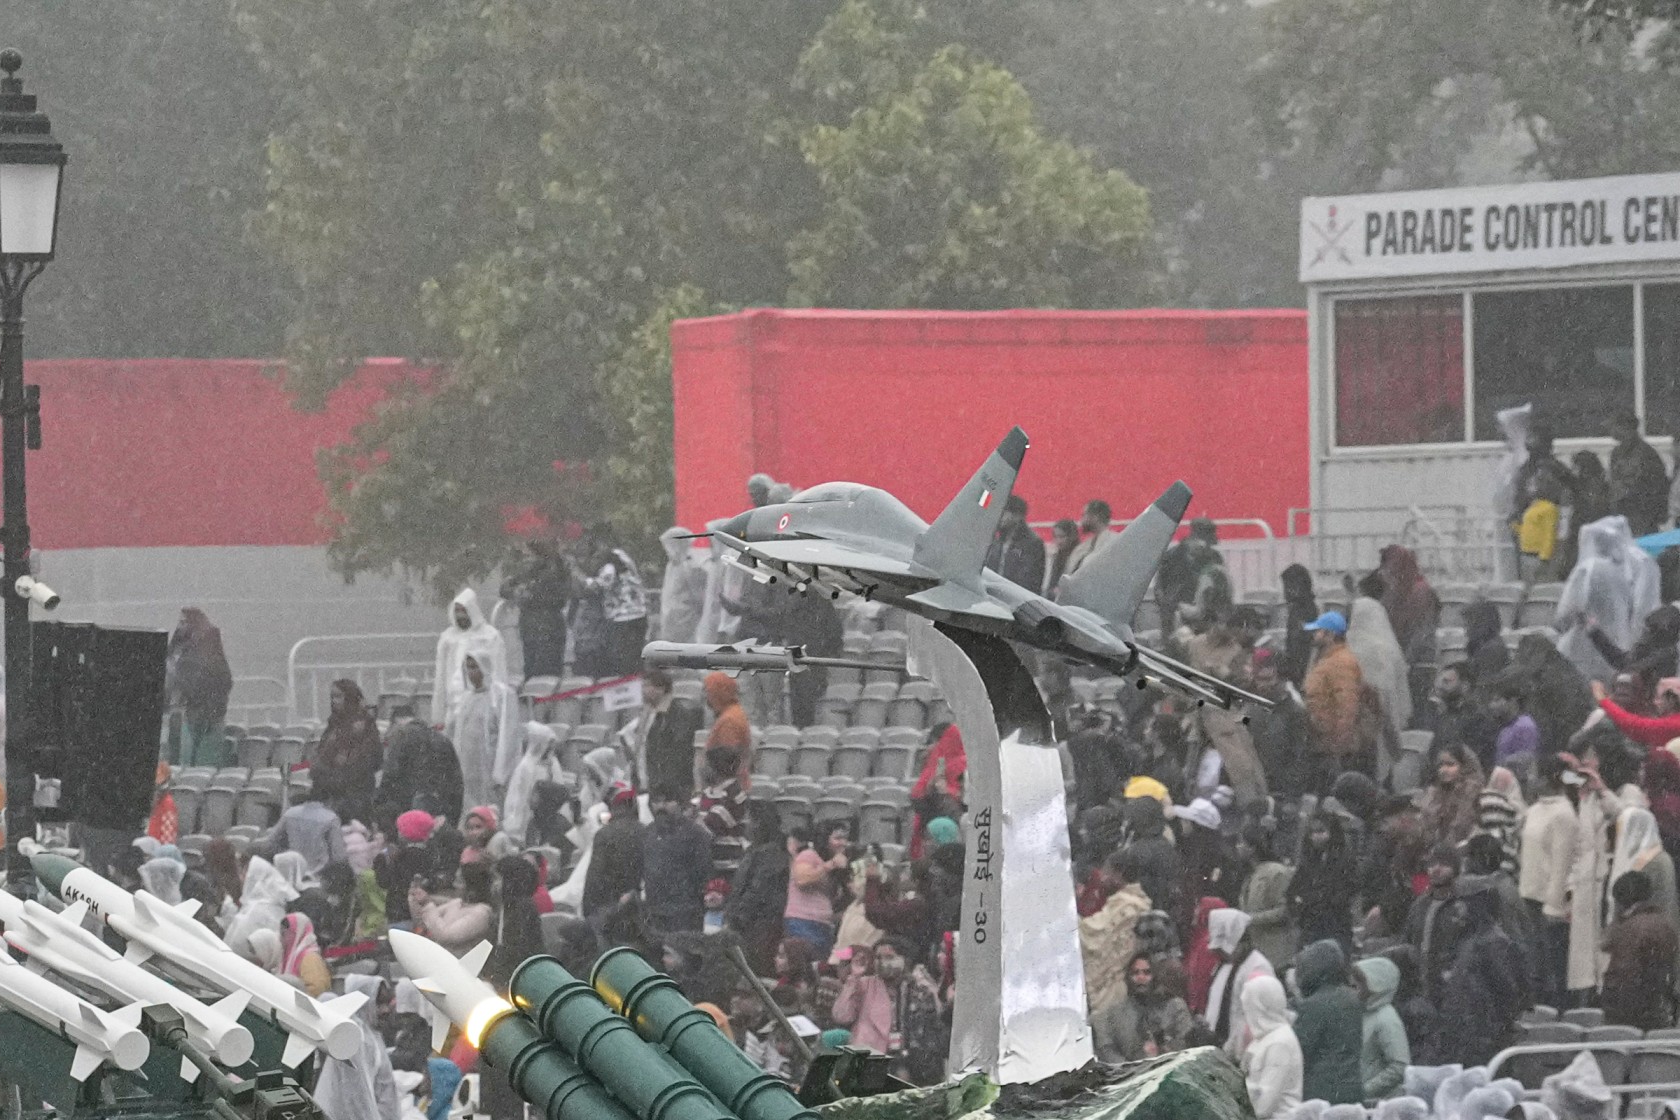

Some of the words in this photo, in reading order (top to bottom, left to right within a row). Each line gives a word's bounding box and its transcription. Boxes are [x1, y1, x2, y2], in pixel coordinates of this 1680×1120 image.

[1365, 206, 1474, 256] PARADE
[1483, 200, 1614, 251] CONTROL
[973, 805, 995, 882] सुखोई
